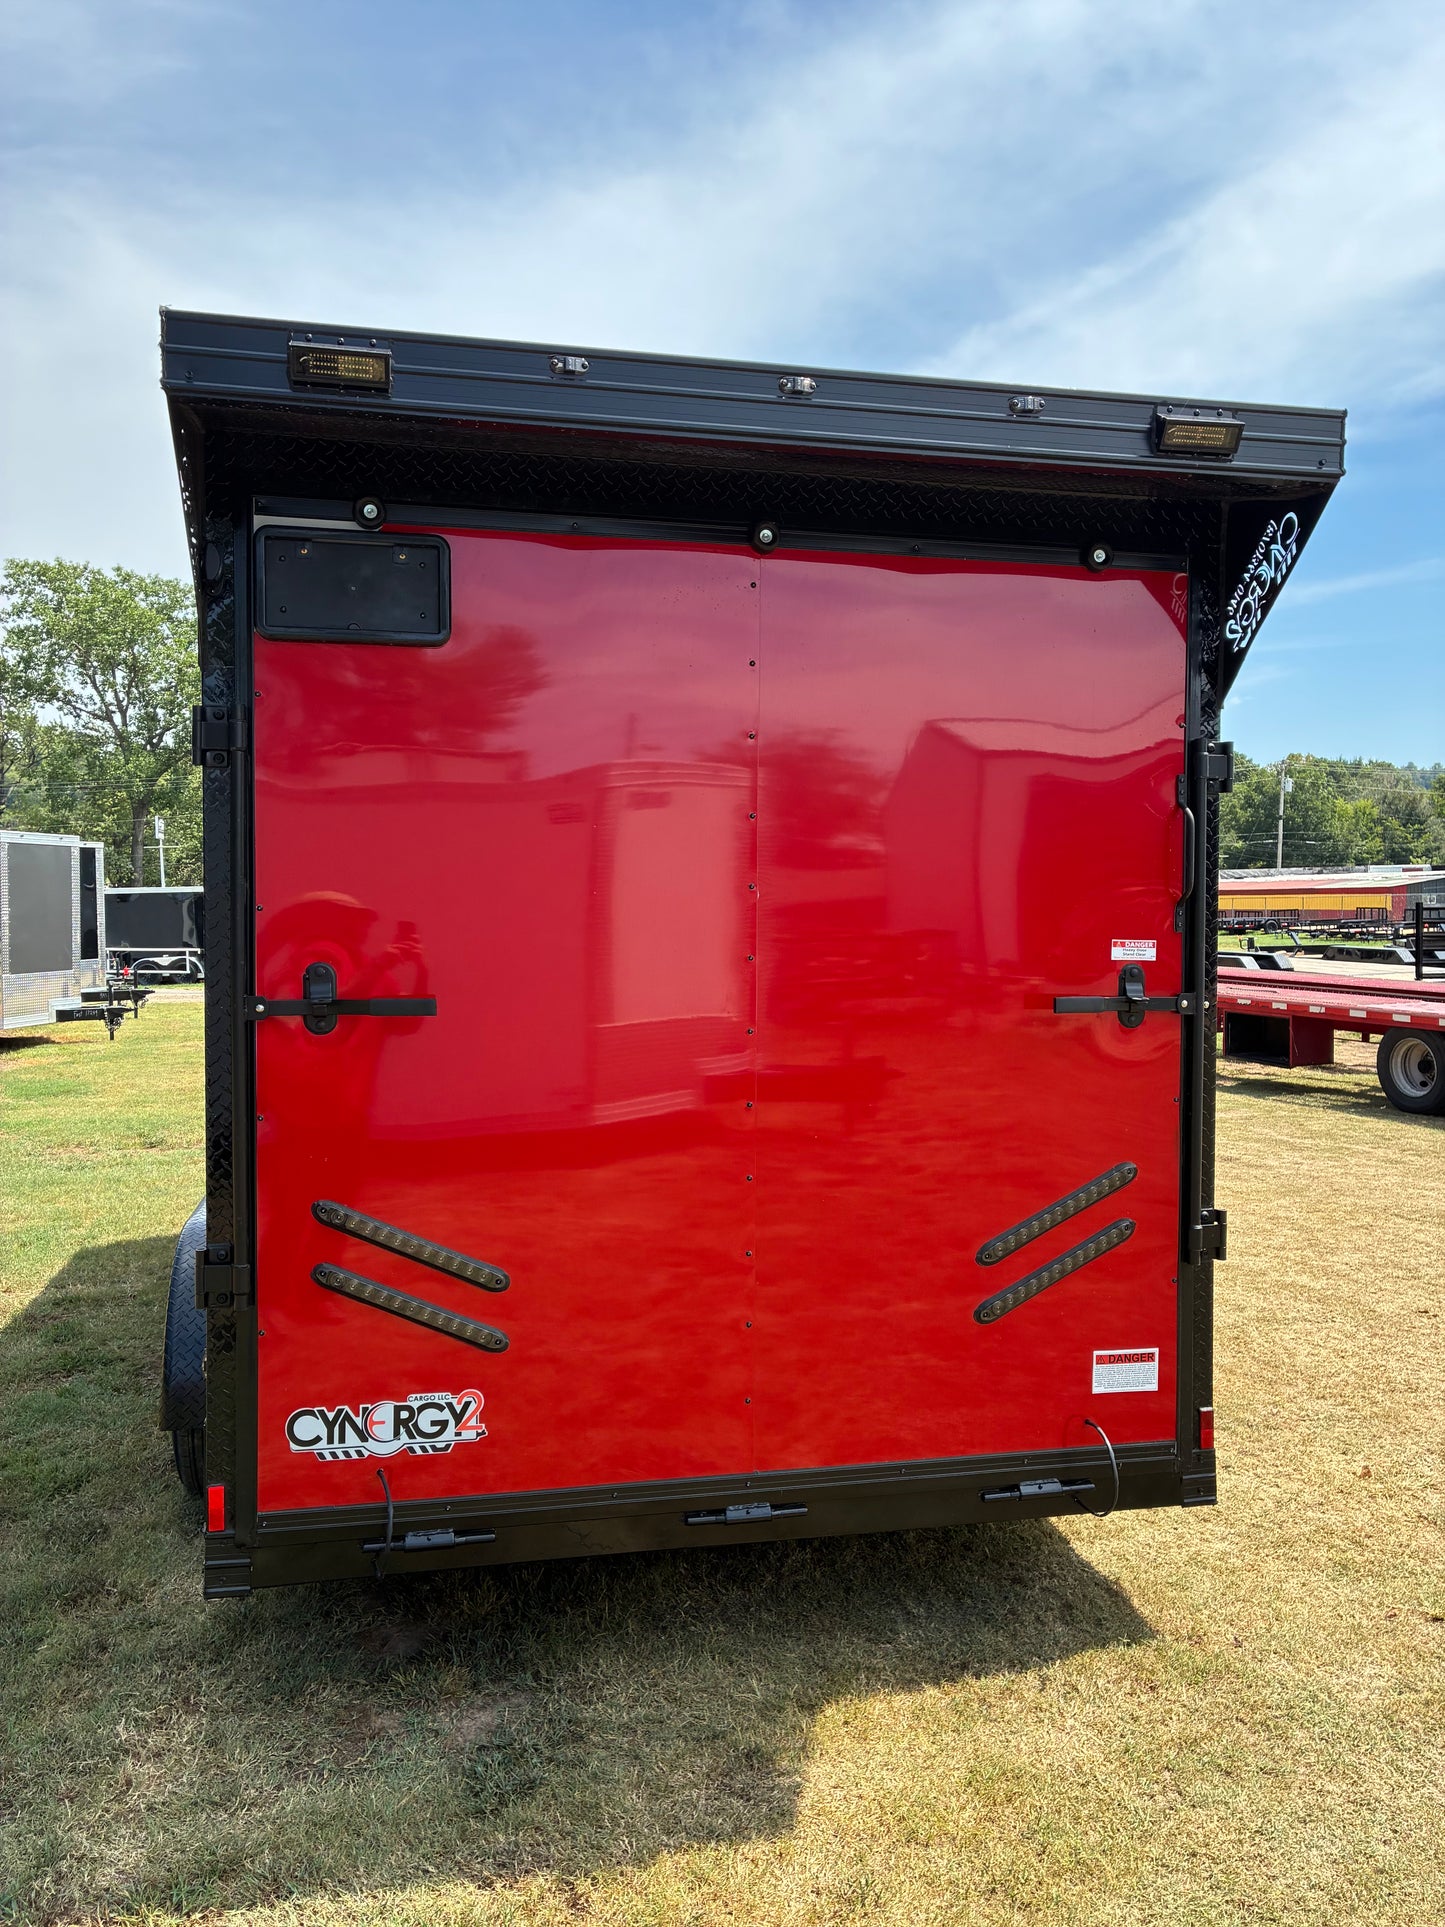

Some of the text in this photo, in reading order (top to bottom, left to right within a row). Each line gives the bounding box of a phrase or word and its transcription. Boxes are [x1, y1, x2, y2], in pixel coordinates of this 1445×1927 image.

[1108, 1352, 1155, 1364] DANGER
[407, 1393, 451, 1402] CARGO LLC
